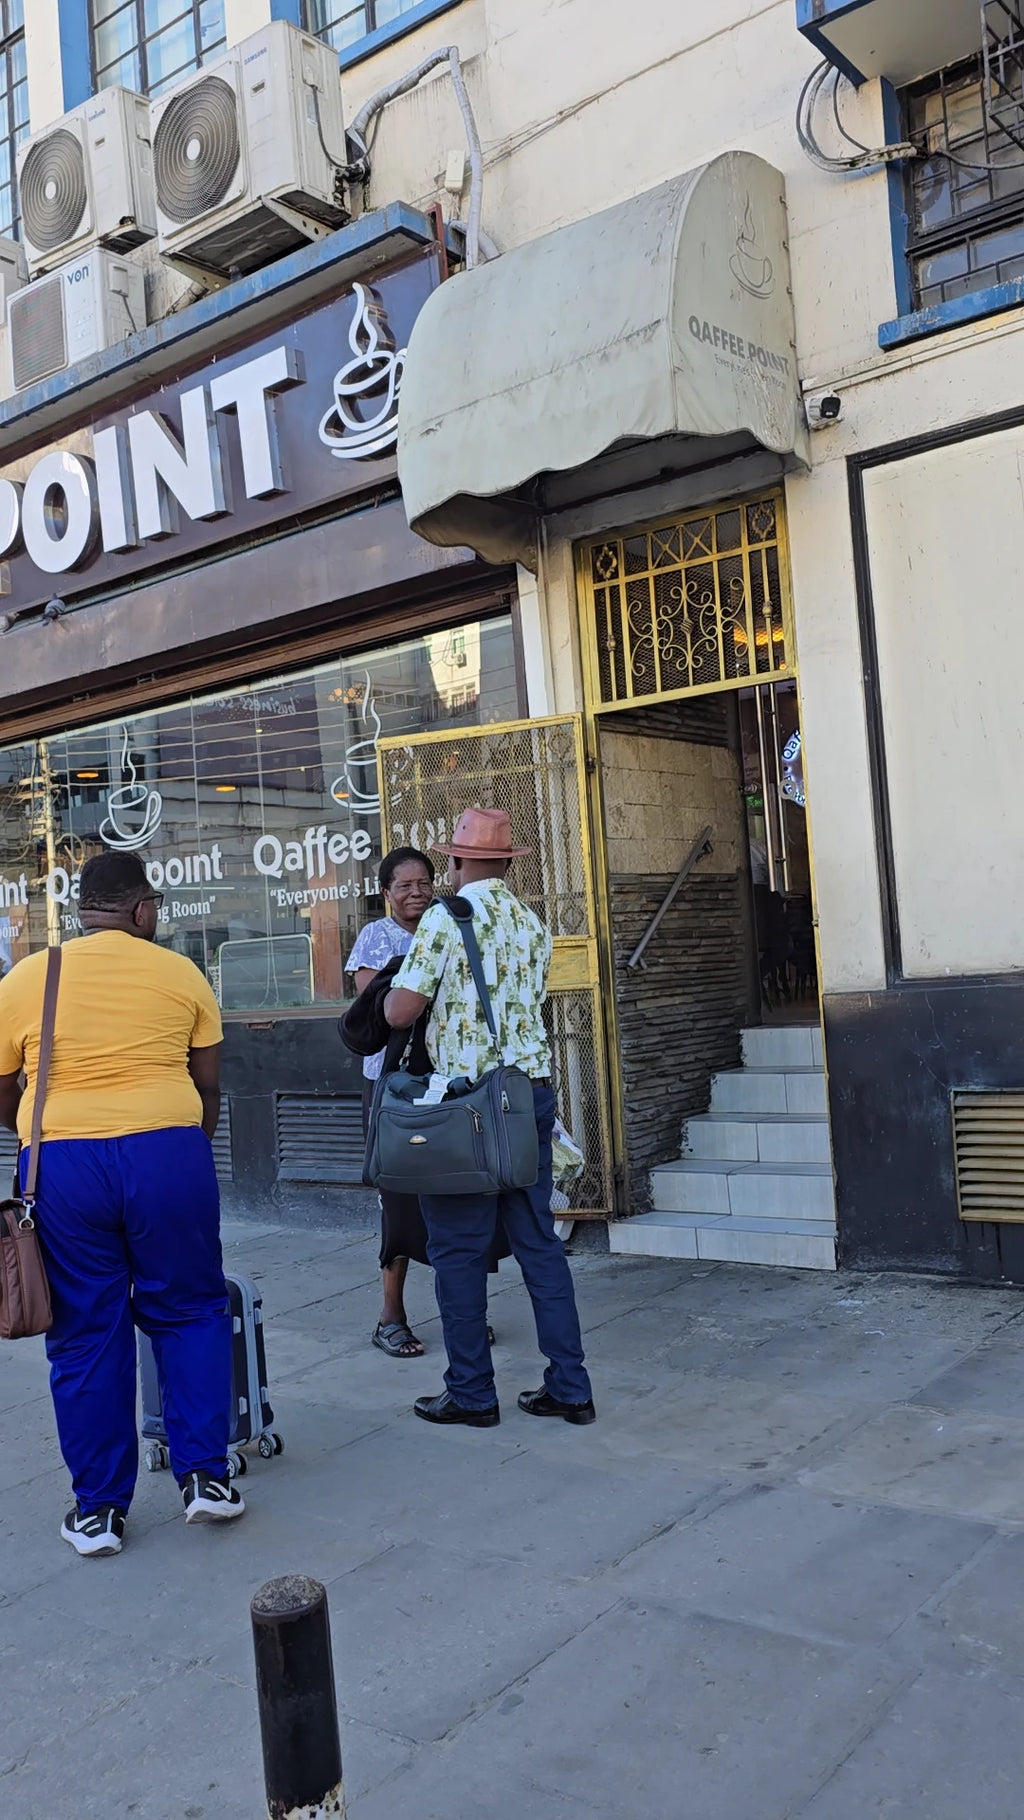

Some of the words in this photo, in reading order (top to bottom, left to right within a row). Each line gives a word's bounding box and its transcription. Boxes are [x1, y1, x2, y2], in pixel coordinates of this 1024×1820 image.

[688, 315, 745, 359] QAFFEE
[748, 342, 790, 377] POINT
[146, 843, 223, 888] point
[253, 825, 372, 879] Qaffee
